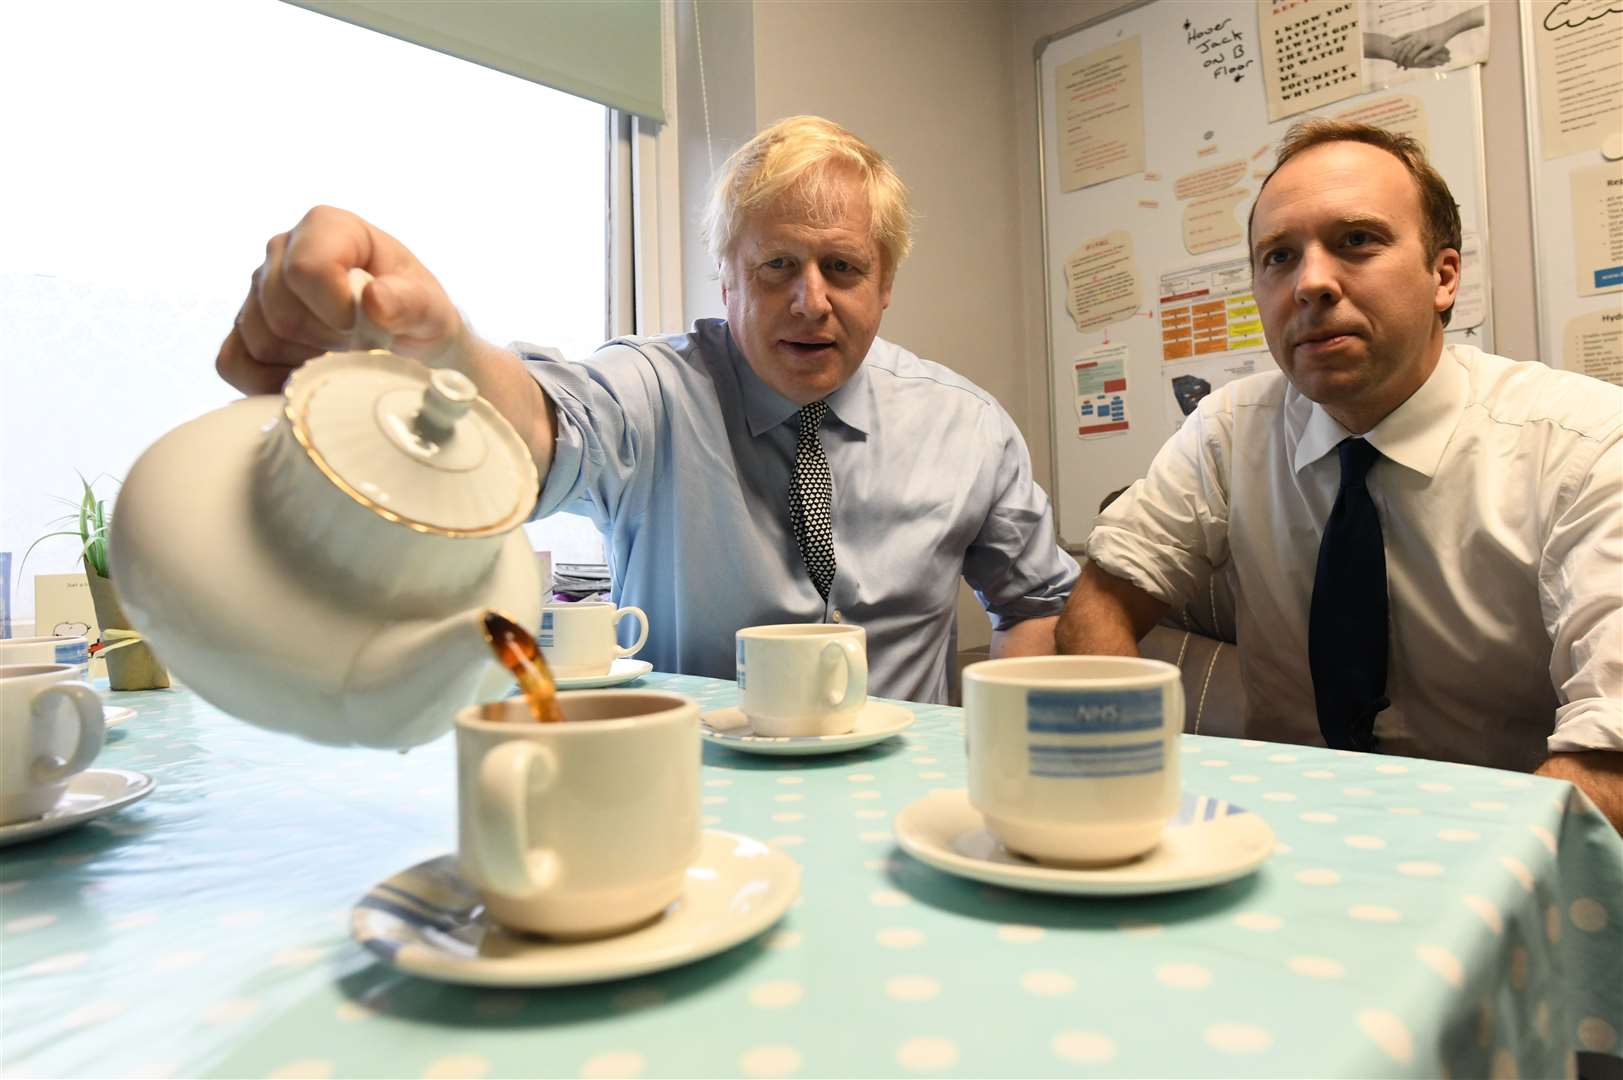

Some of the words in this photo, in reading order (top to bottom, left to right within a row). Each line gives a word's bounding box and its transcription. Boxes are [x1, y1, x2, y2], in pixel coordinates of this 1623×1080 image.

[1284, 15, 1320, 32] KNOW
[1326, 3, 1353, 17] YOU
[1195, 30, 1242, 54] Jack
[1277, 31, 1328, 54] ALWAYS
[1331, 20, 1359, 35] GOT
[1278, 49, 1303, 63] THE
[1305, 34, 1348, 54] STAFF
[1233, 44, 1244, 59] B
[1279, 62, 1295, 73] TO
[1298, 45, 1345, 66] WATCH
[1214, 60, 1253, 79] Floor
[1281, 64, 1349, 92] DOCUMENT
[1282, 86, 1310, 101] WHY
[1076, 704, 1120, 722] NHS
